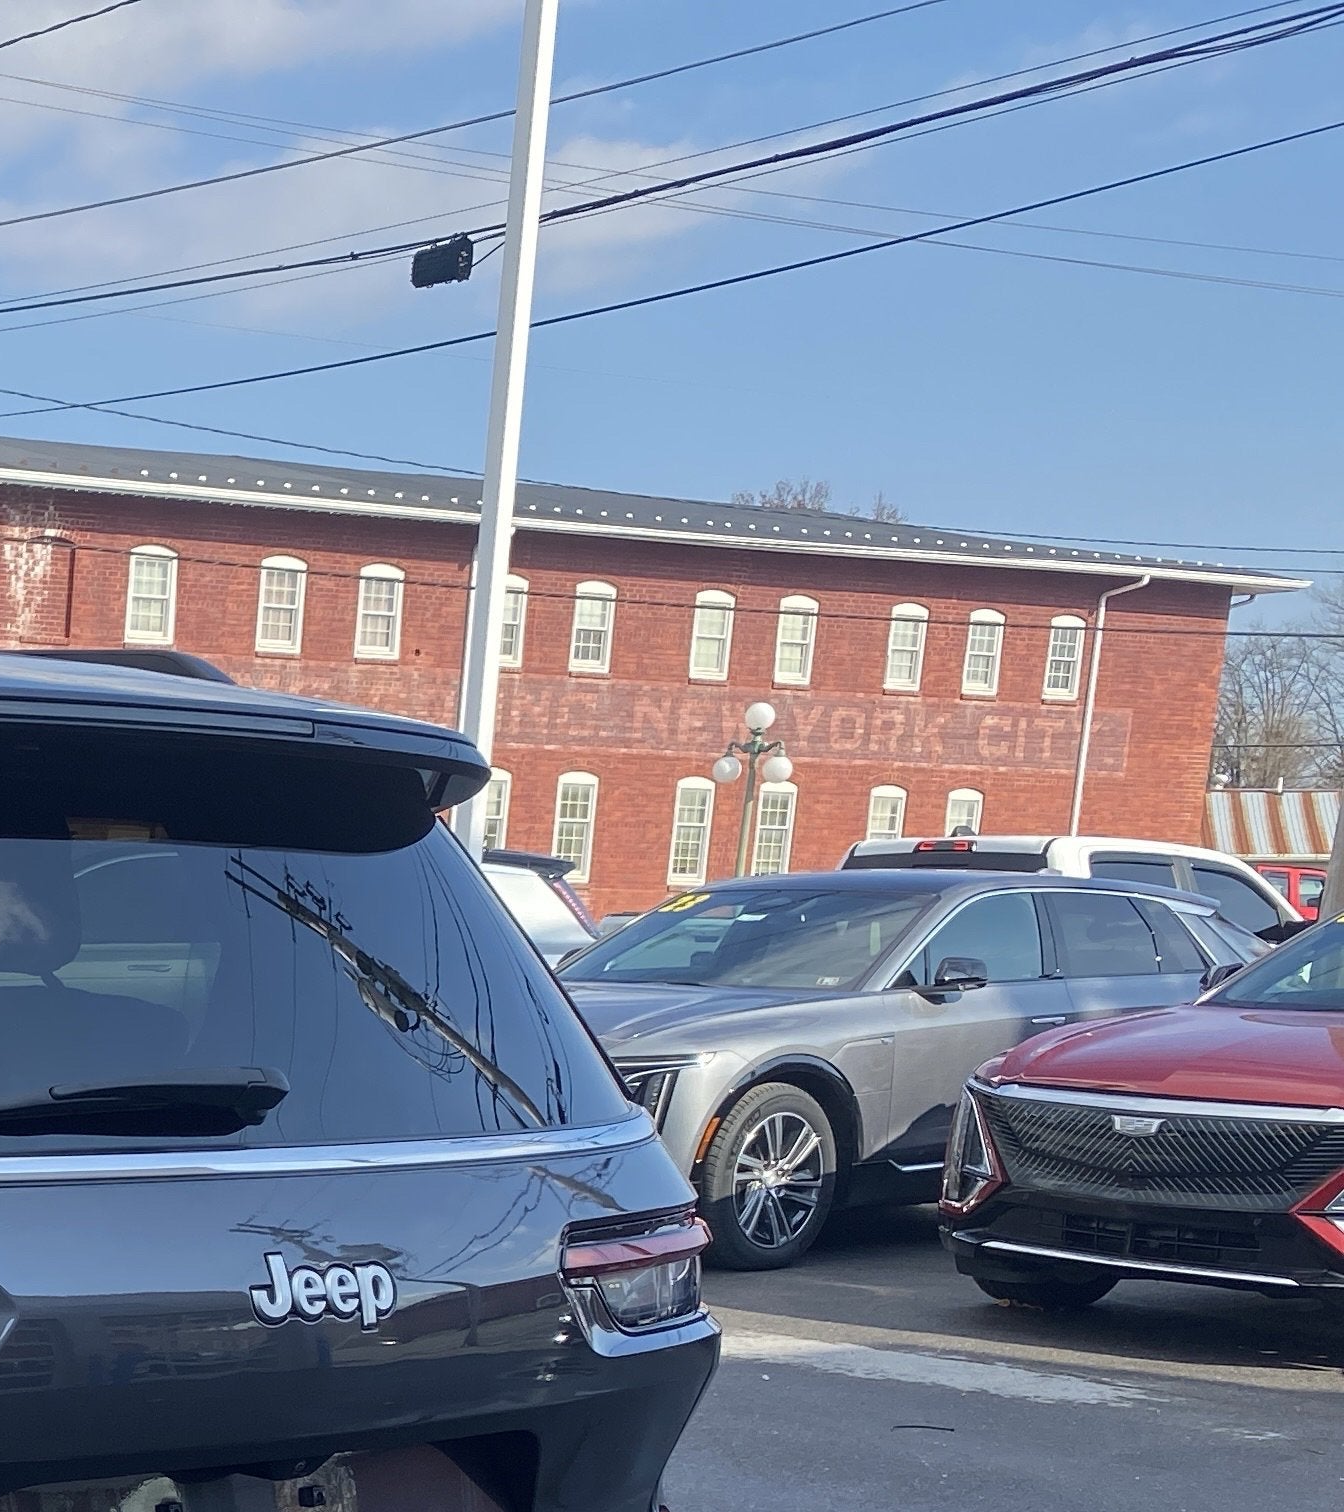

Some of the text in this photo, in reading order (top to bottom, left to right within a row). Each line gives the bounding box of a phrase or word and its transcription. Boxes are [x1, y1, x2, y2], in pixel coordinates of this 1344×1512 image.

[630, 692, 771, 748] NEW
[792, 704, 953, 764] YORK
[250, 1251, 395, 1331] Jeep
